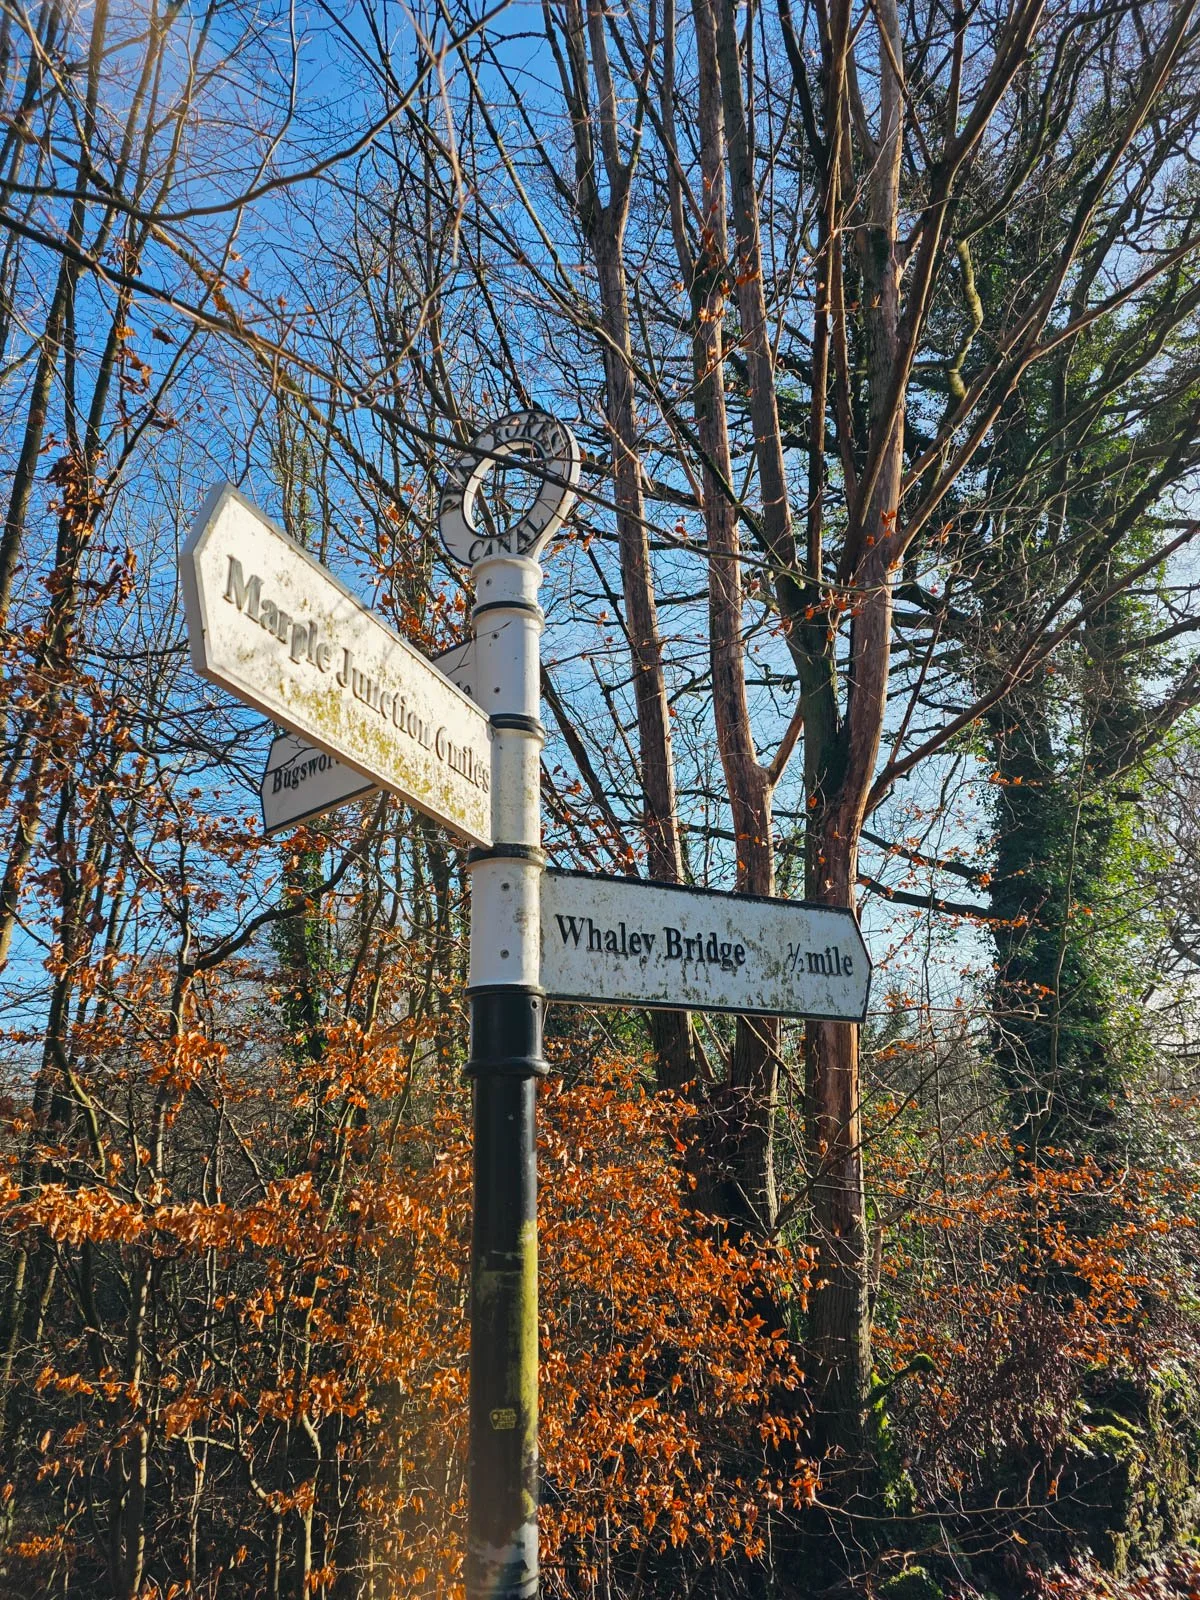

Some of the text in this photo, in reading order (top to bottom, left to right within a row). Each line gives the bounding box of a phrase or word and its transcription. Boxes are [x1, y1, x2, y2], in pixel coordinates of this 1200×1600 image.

[468, 518, 545, 562] CANAL
[222, 555, 331, 673] Marple
[335, 647, 431, 751] Junction
[271, 754, 339, 794] Bugswor
[555, 914, 655, 963] Whaley
[663, 926, 746, 971] Bridge
